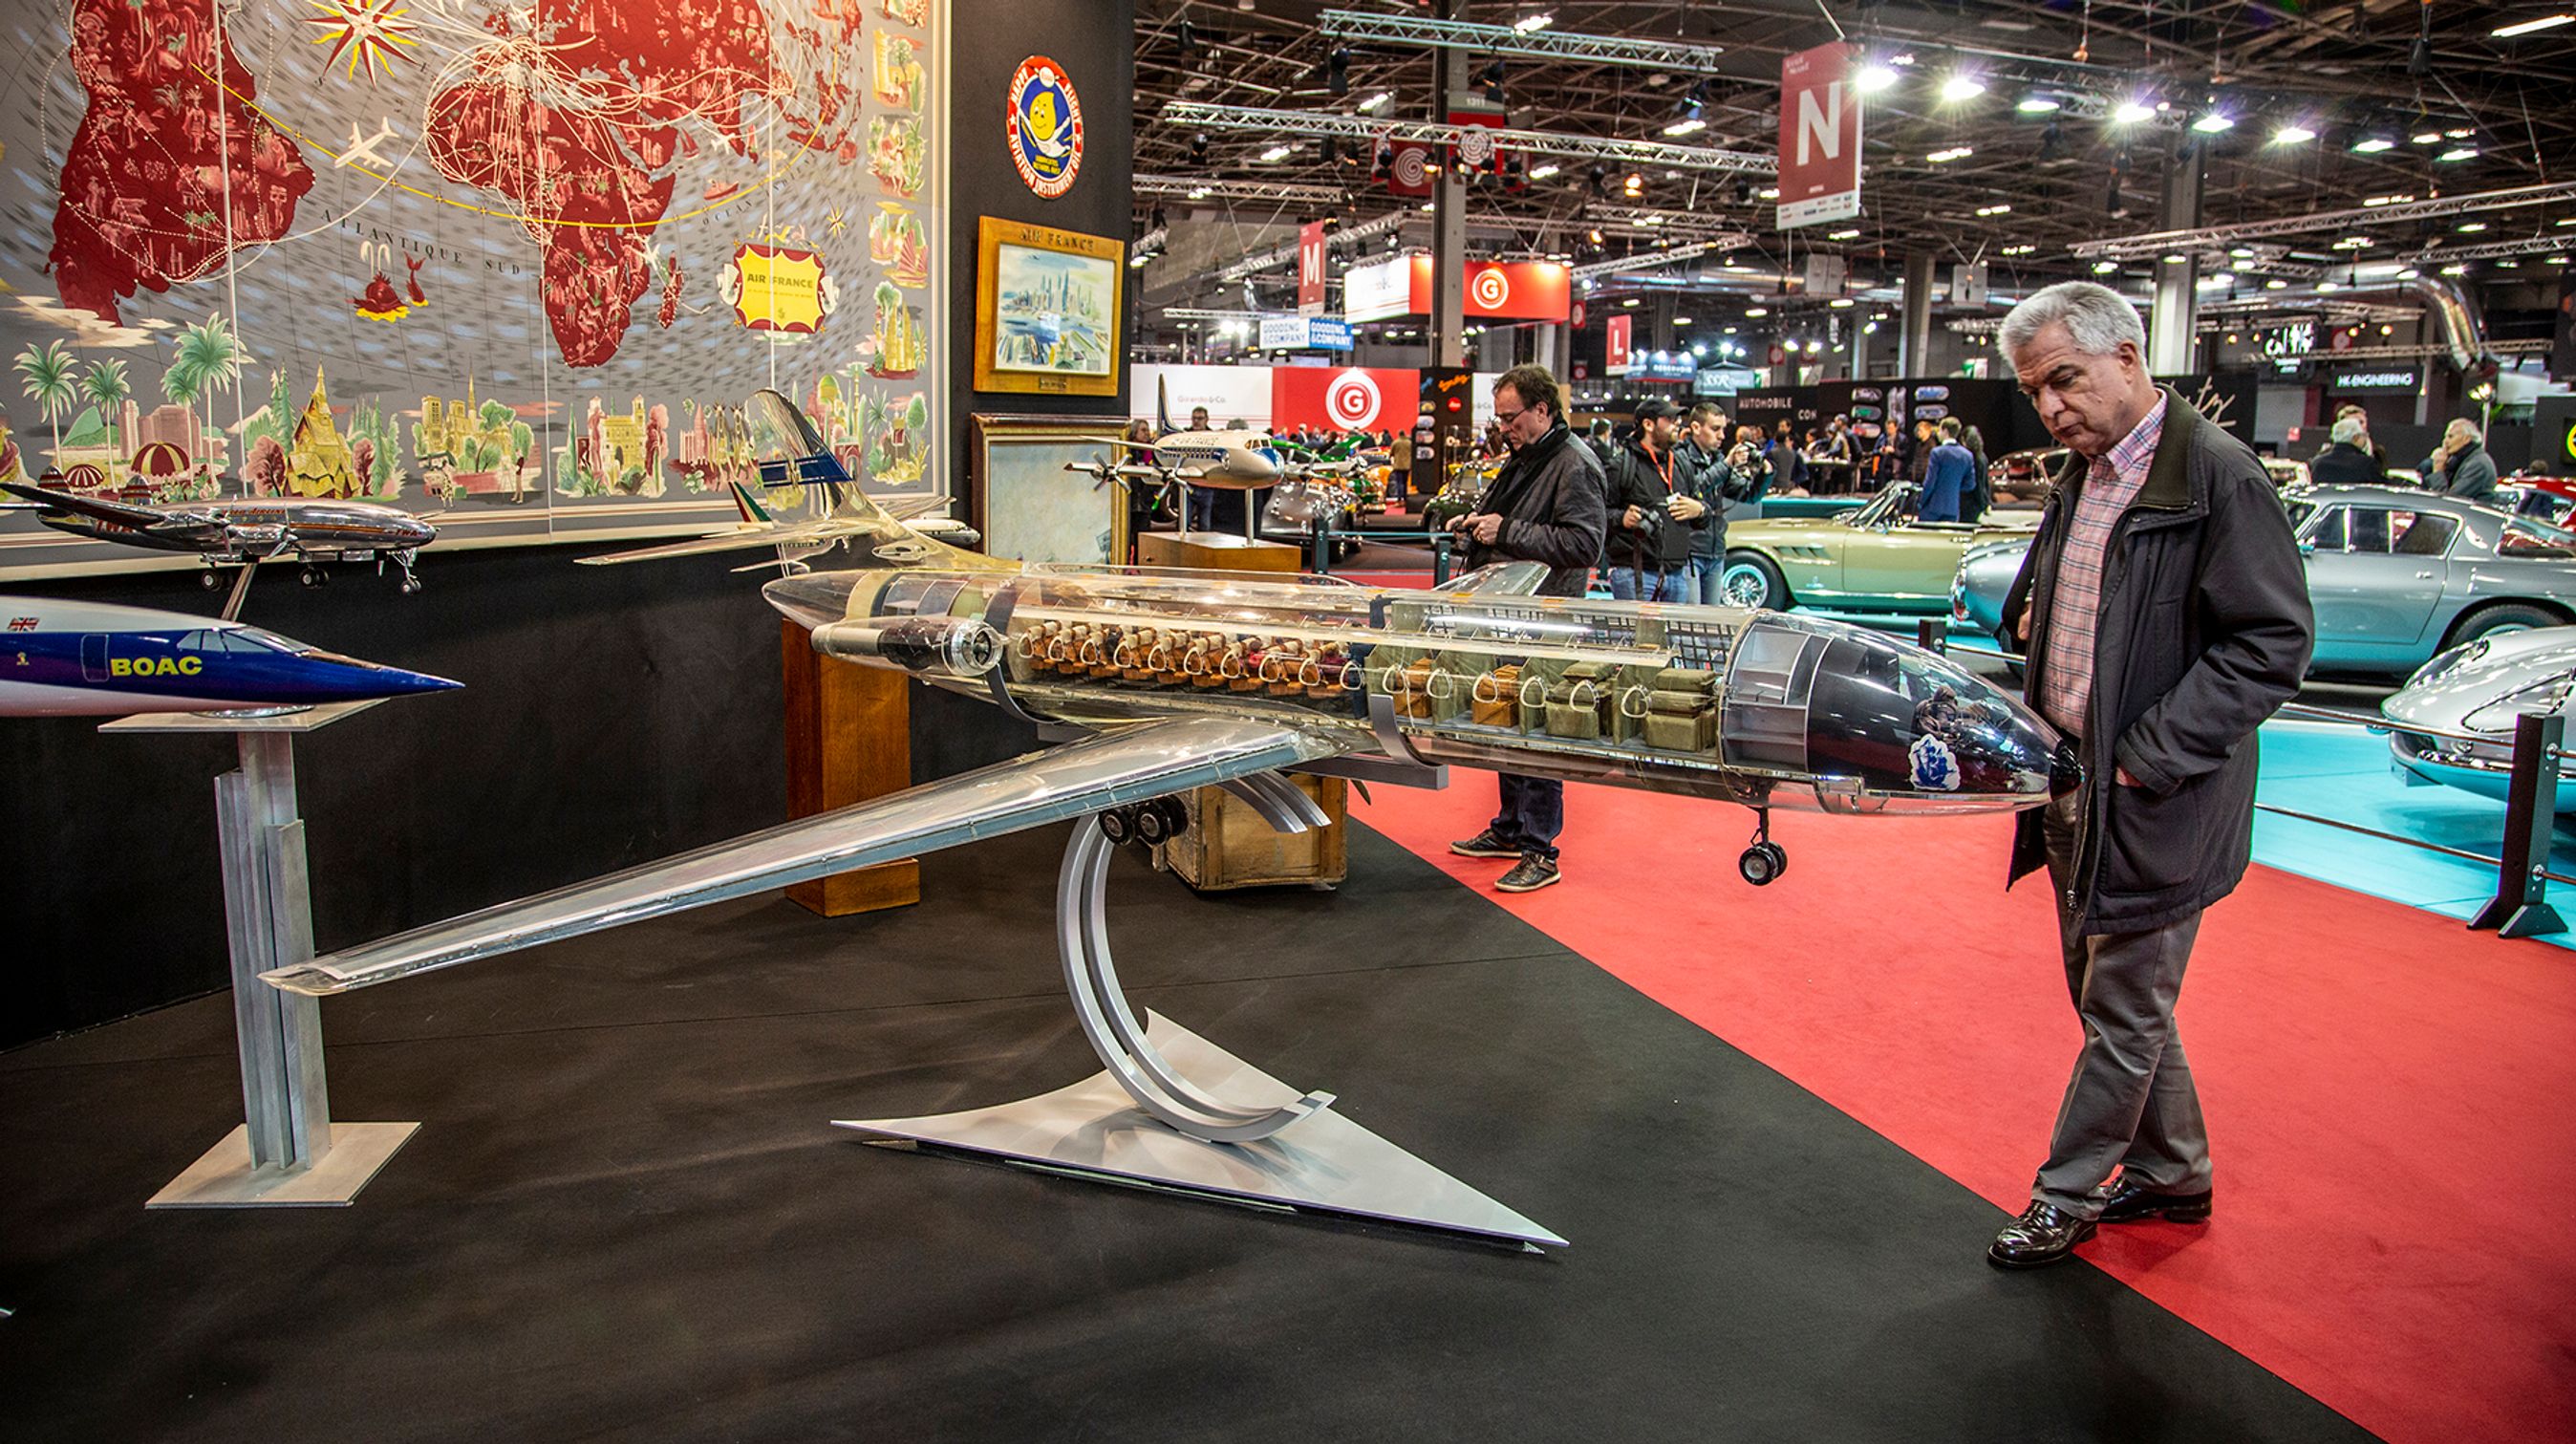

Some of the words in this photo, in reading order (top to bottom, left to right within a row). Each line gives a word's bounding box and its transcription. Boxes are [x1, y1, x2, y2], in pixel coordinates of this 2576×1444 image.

[1796, 80, 1841, 166] N
[1009, 134, 1037, 187] AVIATION
[321, 209, 462, 263] ATLANTIQUE
[485, 259, 521, 275] SUD
[1020, 227, 1042, 243] AIR
[1047, 232, 1095, 252] FRANCE
[1303, 242, 1320, 287] M
[747, 273, 766, 284] AIR
[771, 274, 813, 289] FRANCE
[1481, 279, 1499, 300] G
[1613, 330, 1623, 356] L
[1343, 389, 1364, 414] G
[1739, 397, 1792, 409] AUTOMOBILE
[395, 528, 419, 537] TWA
[110, 656, 203, 676] BOAC
